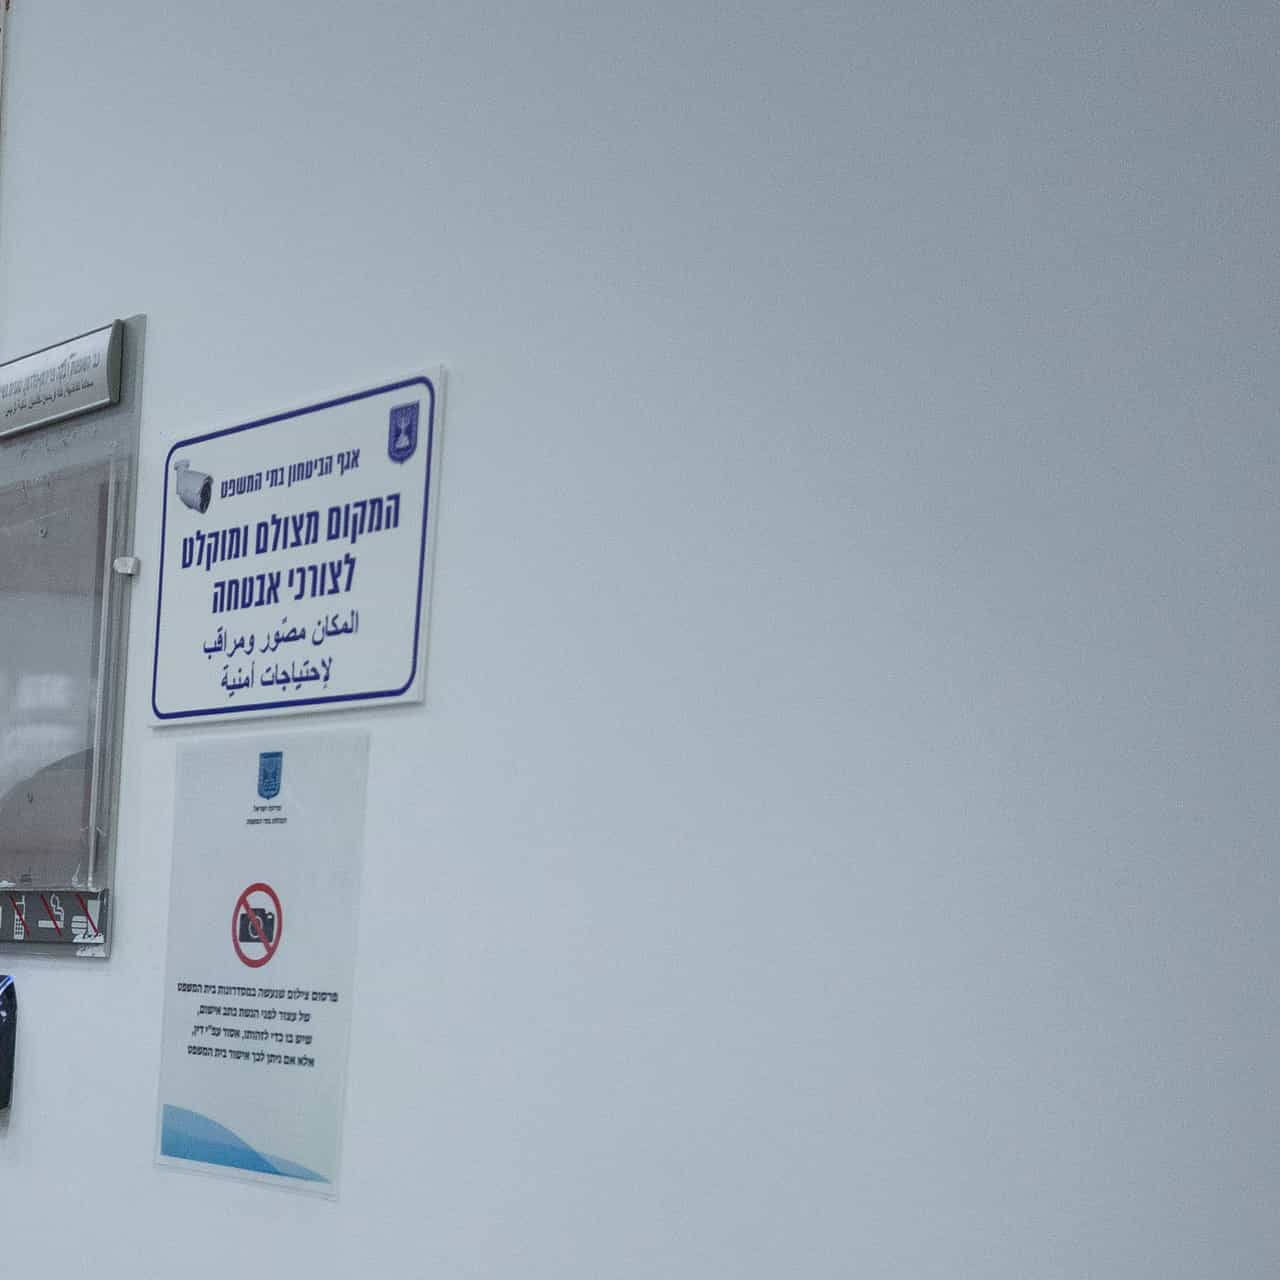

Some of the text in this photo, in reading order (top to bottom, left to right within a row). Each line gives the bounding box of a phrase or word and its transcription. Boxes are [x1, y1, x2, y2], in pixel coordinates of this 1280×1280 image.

[220, 449, 360, 498] אגף הביטחון בתי המשפט
[181, 493, 400, 571] המקום מצולם ומוקלט
[211, 552, 356, 614] לצורכי אבטחה
[203, 625, 255, 660] ومراقب
[311, 609, 359, 646] المكان
